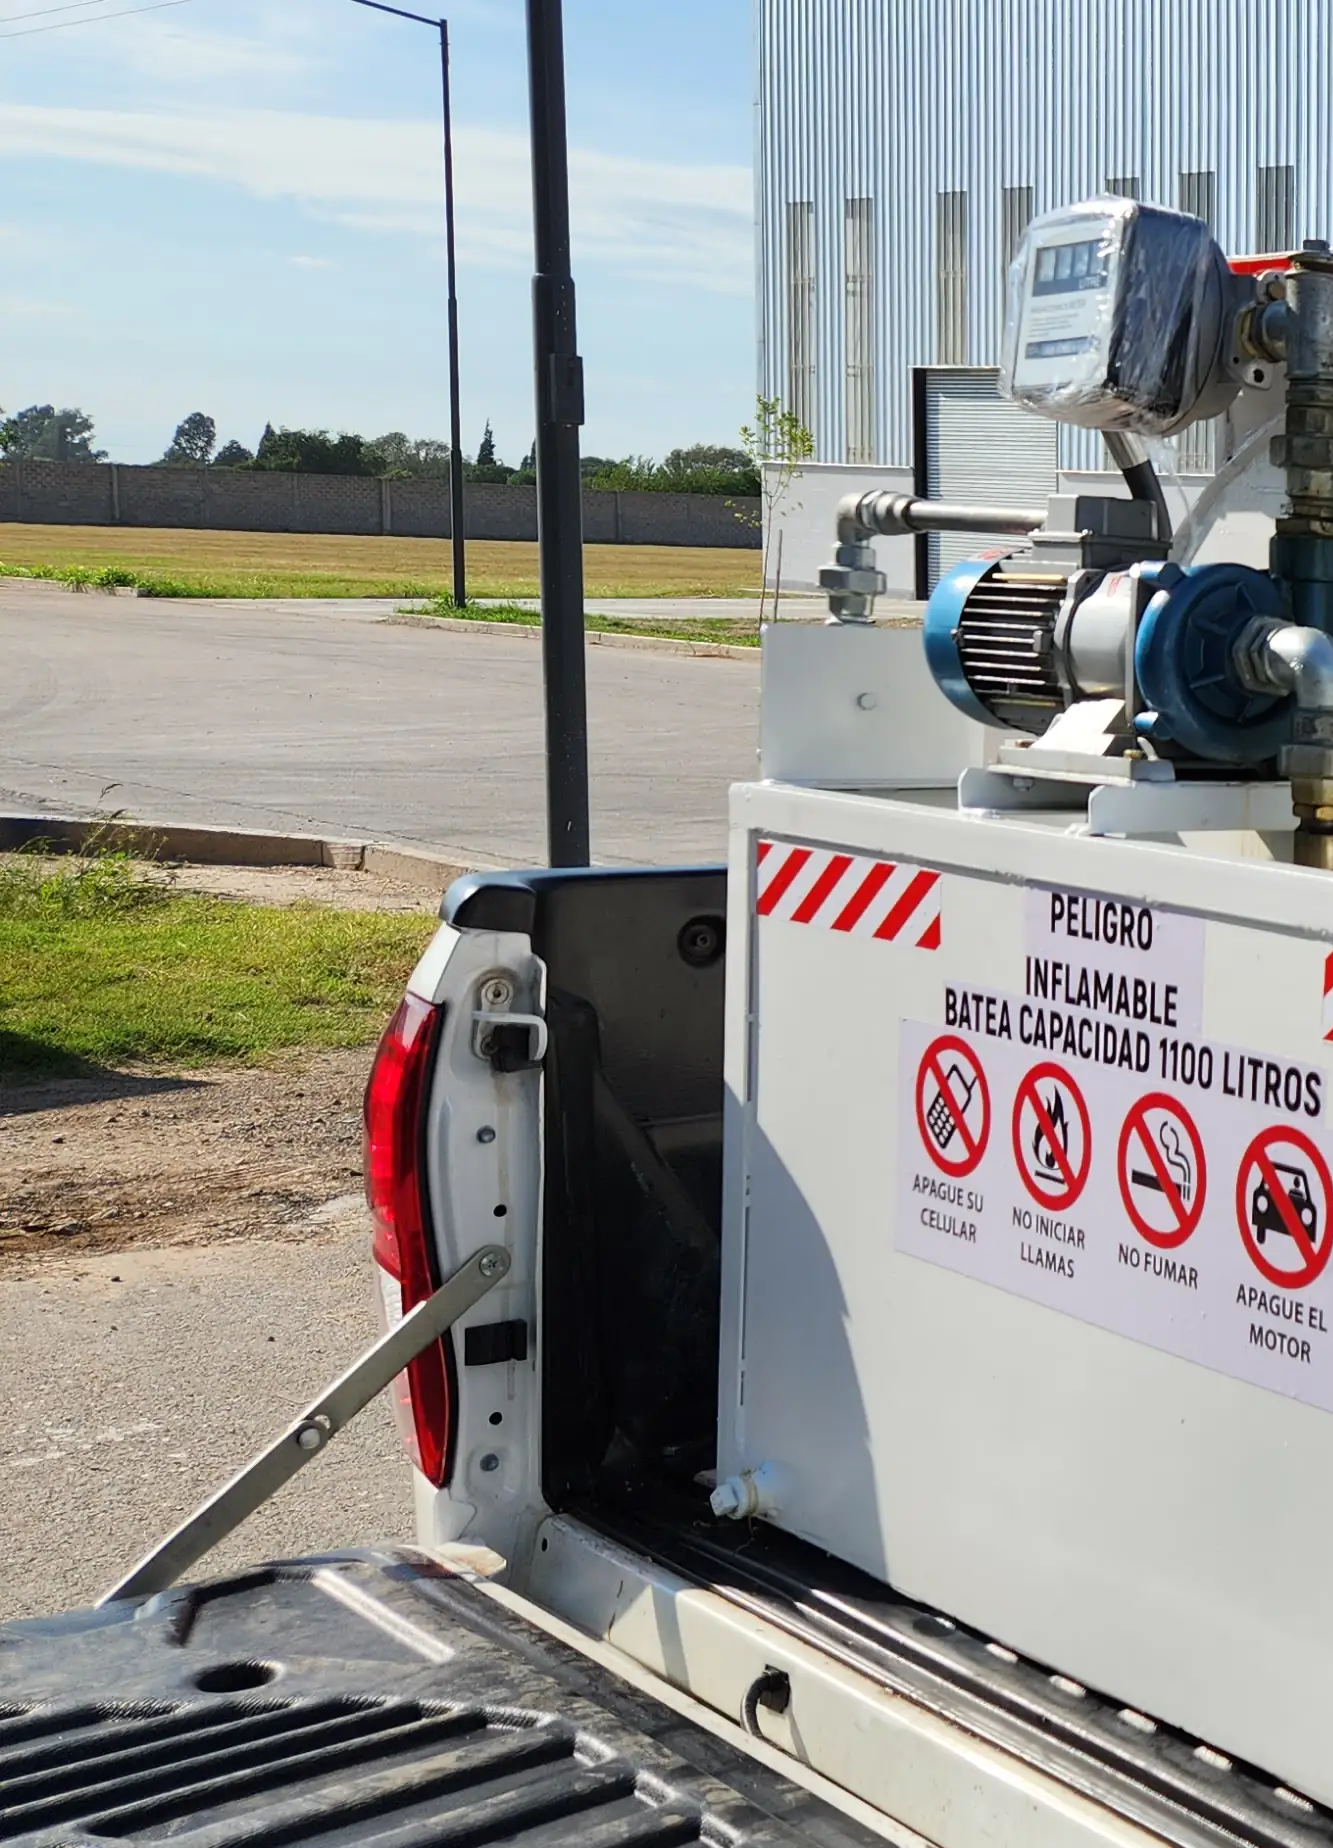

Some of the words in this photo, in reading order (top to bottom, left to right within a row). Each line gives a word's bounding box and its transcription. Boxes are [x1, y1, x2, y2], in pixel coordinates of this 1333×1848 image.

[1050, 893, 1153, 950] PELIGRO
[1026, 956, 1178, 1028] INFLAMABLE
[945, 988, 1011, 1040] BATEA
[1020, 1010, 1150, 1073] CAPACIDAD
[1159, 1039, 1212, 1089] 1100
[1223, 1052, 1322, 1117] LITROS
[912, 1174, 964, 1209] APAGUE
[967, 1190, 984, 1213] SU
[920, 1208, 977, 1243] CELULAR
[1012, 1207, 1032, 1230] NO
[1035, 1214, 1086, 1249] INICIAR
[1020, 1246, 1075, 1279] LLAMAS
[1118, 1244, 1140, 1269] NO
[1144, 1252, 1199, 1290] FUMAR
[1236, 1284, 1303, 1323] APAGUE
[1309, 1308, 1328, 1332] EL
[1249, 1323, 1311, 1364] MOTOR
